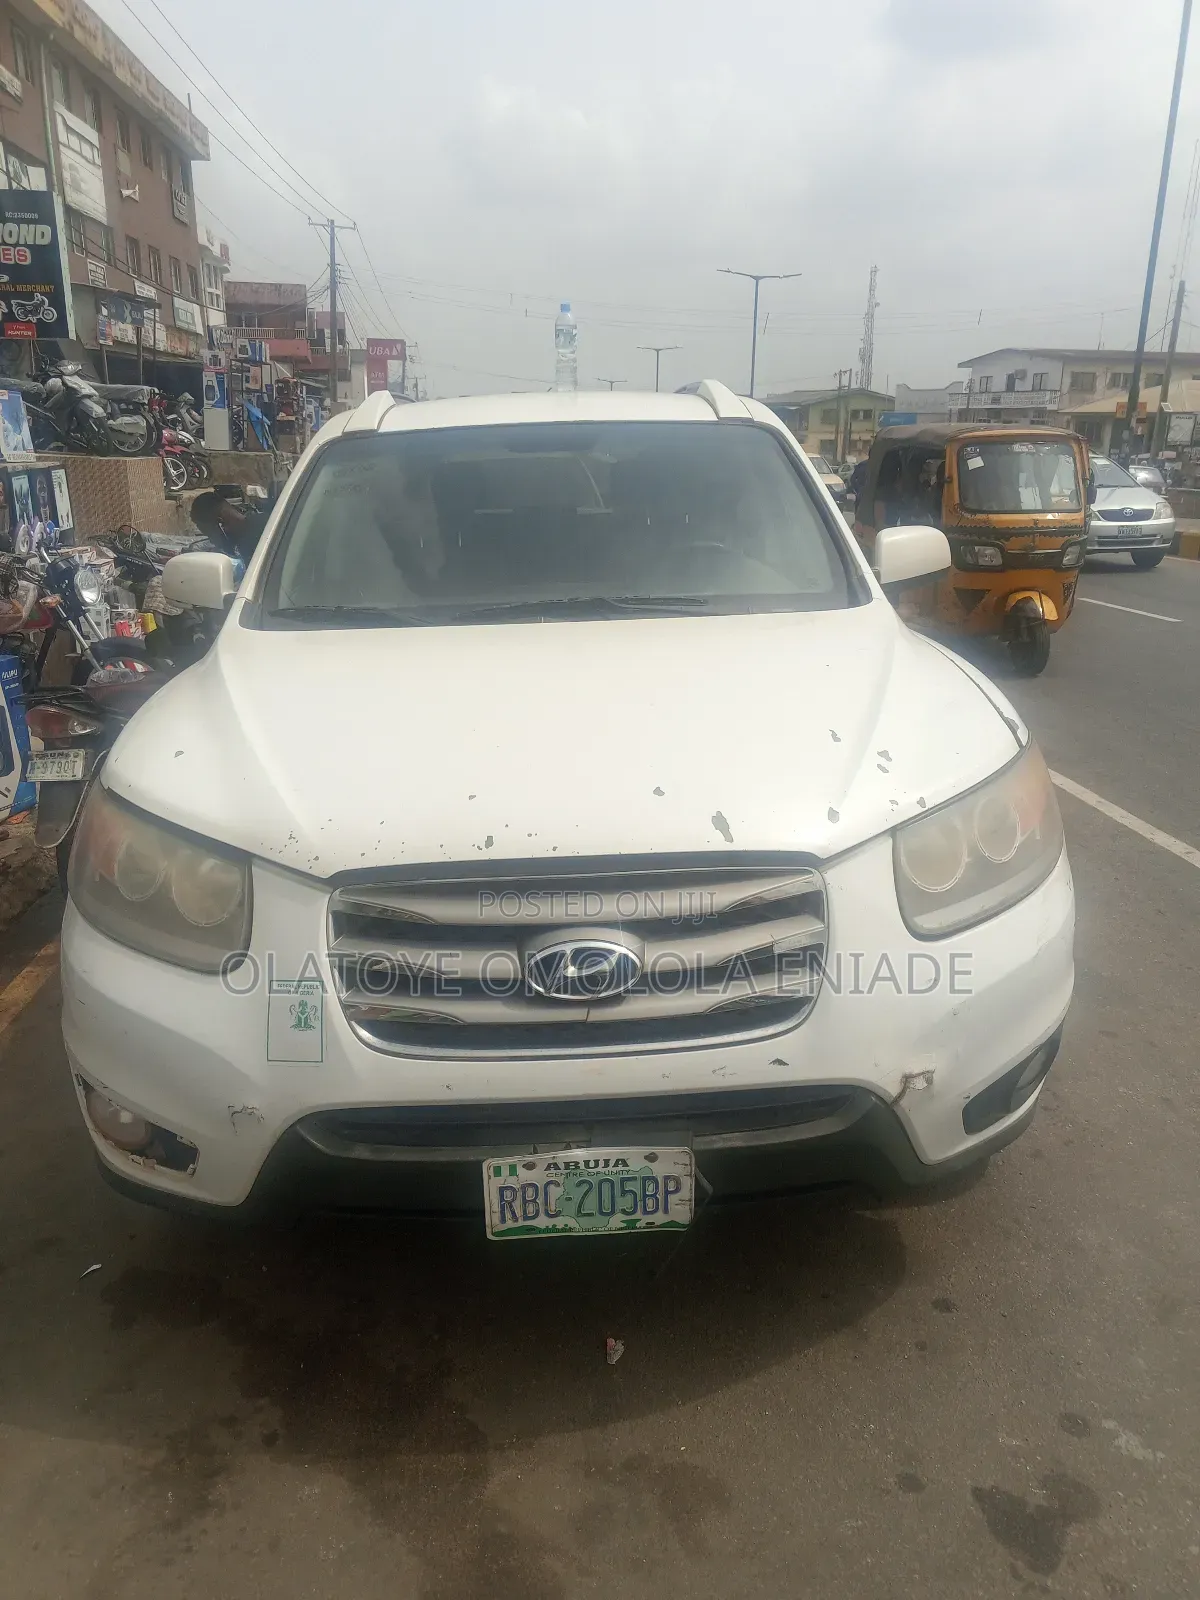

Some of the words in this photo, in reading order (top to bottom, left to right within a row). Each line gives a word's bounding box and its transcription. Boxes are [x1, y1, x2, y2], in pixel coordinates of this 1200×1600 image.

[0, 223, 51, 245] OND
[0, 283, 15, 291] RAL
[16, 284, 55, 293] MERCHANT
[369, 346, 390, 356] UBA
[543, 1158, 630, 1171] ABUJA
[602, 1169, 631, 1177] UNITY
